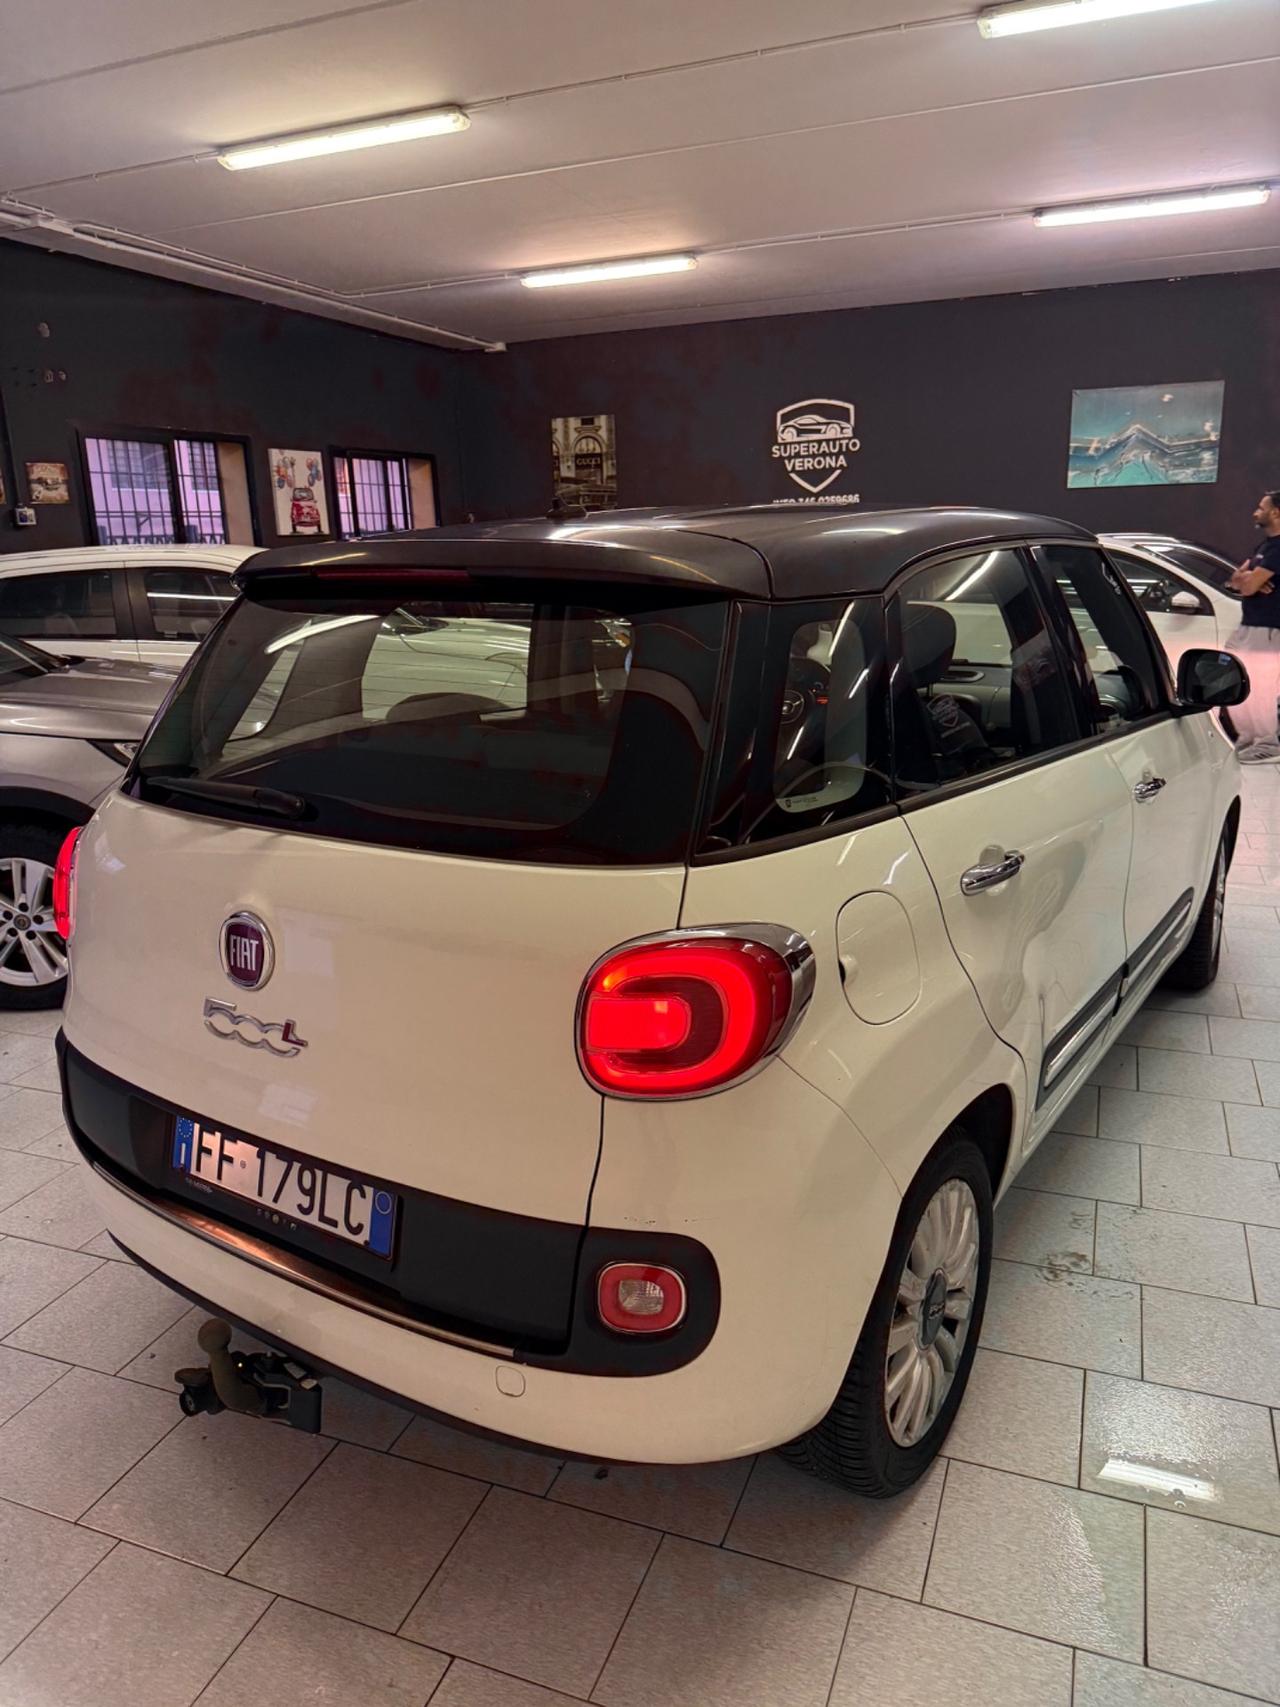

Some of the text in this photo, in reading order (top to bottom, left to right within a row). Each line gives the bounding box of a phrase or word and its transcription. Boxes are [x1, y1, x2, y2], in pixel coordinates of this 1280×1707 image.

[771, 438, 861, 458] SUPERAUTO
[784, 455, 848, 471] VERONA
[230, 934, 259, 971] FIAT
